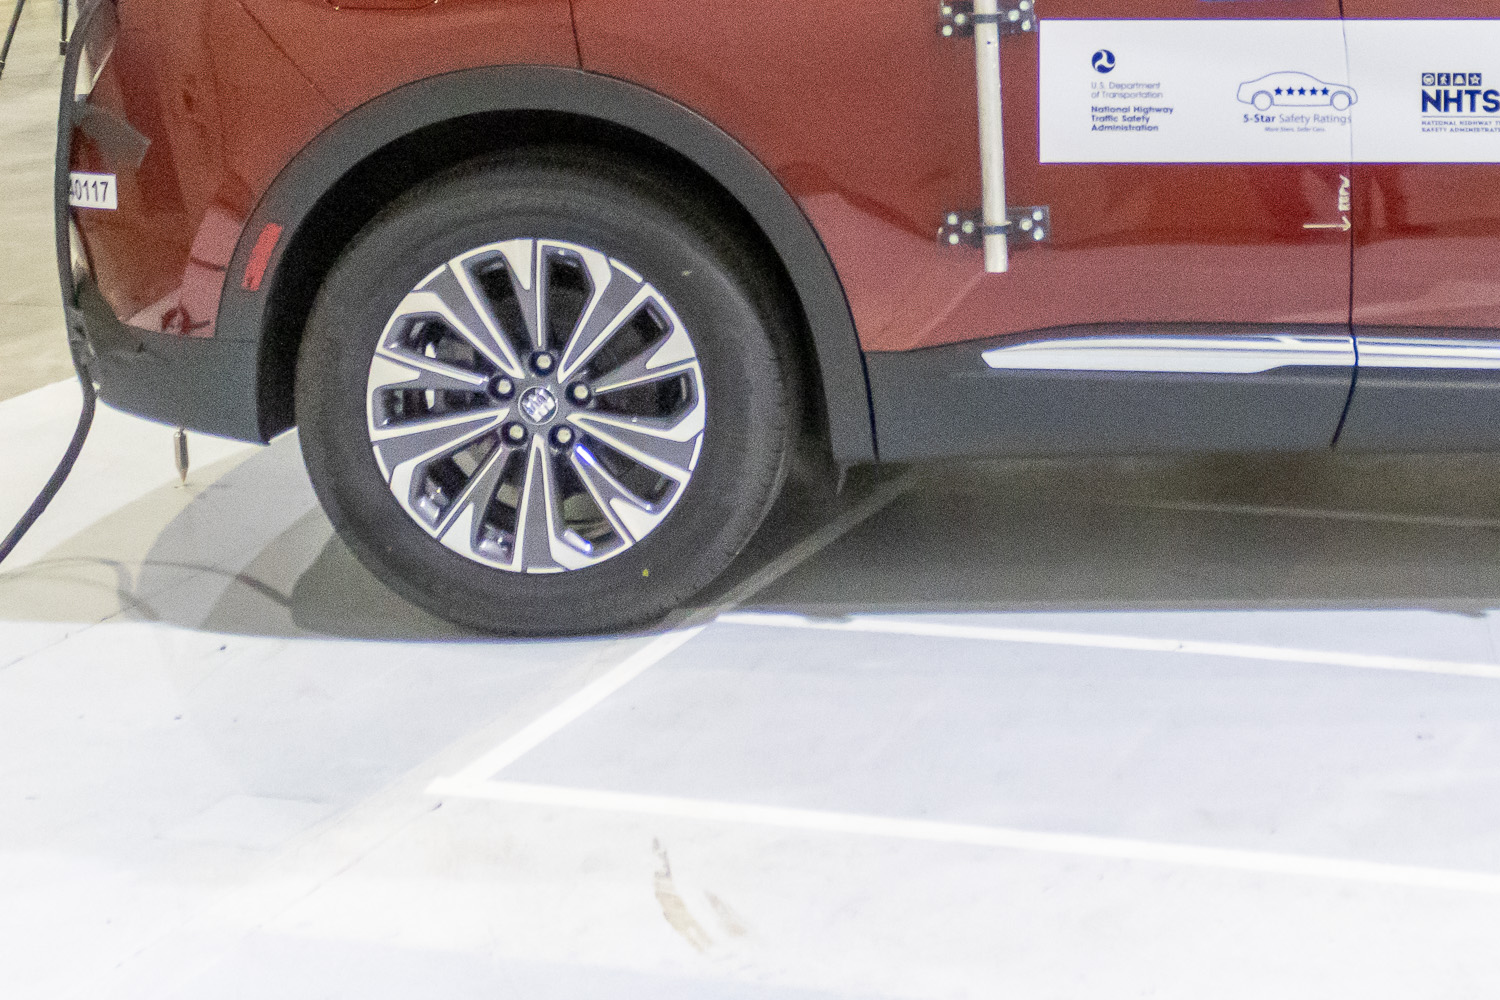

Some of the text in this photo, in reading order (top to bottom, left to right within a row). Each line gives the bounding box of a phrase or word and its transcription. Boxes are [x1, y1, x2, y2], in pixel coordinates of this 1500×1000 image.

[1109, 82, 1160, 90] Department
[1102, 91, 1163, 99] Transportation
[1134, 106, 1173, 115] Highway
[1122, 115, 1150, 124] Safety
[1243, 114, 1352, 127] 5-Star Safety Ratings
